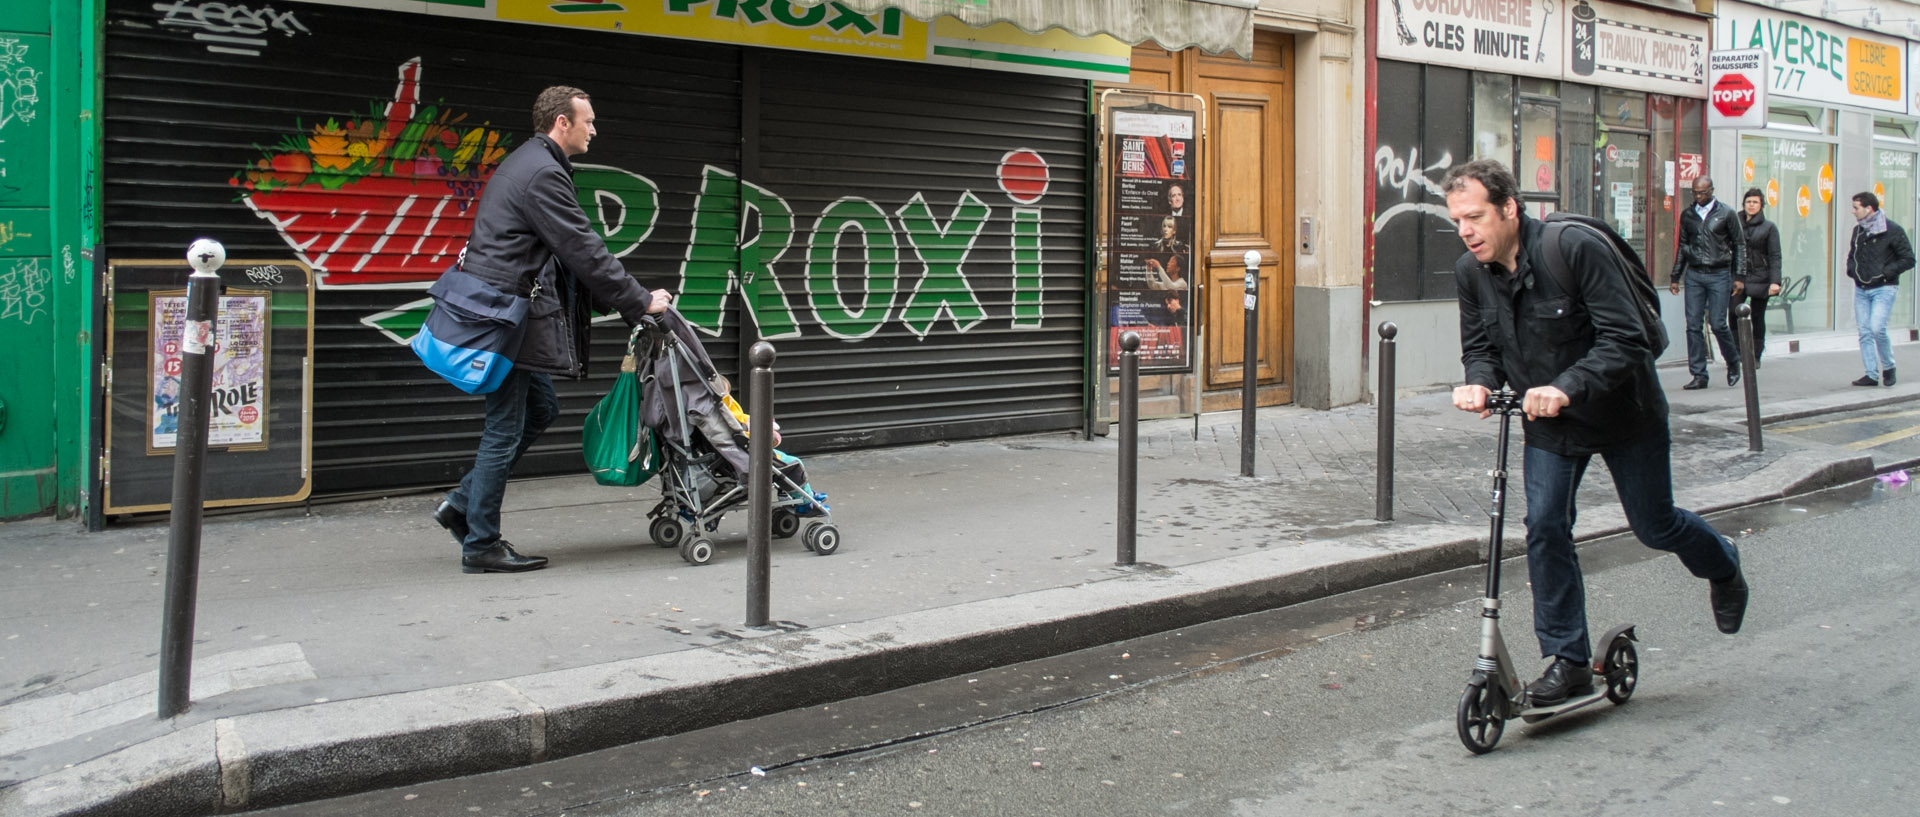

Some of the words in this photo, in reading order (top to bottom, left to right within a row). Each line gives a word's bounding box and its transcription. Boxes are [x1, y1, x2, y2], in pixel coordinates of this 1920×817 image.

[809, 35, 902, 50] SERVICE
[1423, 20, 1465, 52] CLES
[1474, 28, 1529, 60] MINUTE
[1600, 31, 1647, 65] TRAVAUX
[1652, 41, 1687, 71] PHOTO
[1859, 43, 1887, 67] LIBRE
[1712, 62, 1759, 70] CHAUSSURES
[1773, 66, 1806, 92] 7/7
[1854, 71, 1893, 97] SERVICE
[1713, 89, 1754, 103] TOPY
[1122, 141, 1145, 151] SAINT
[1773, 139, 1806, 158] LAVAGE
[1122, 161, 1145, 172] DENIS
[167, 361, 180, 372] 15
